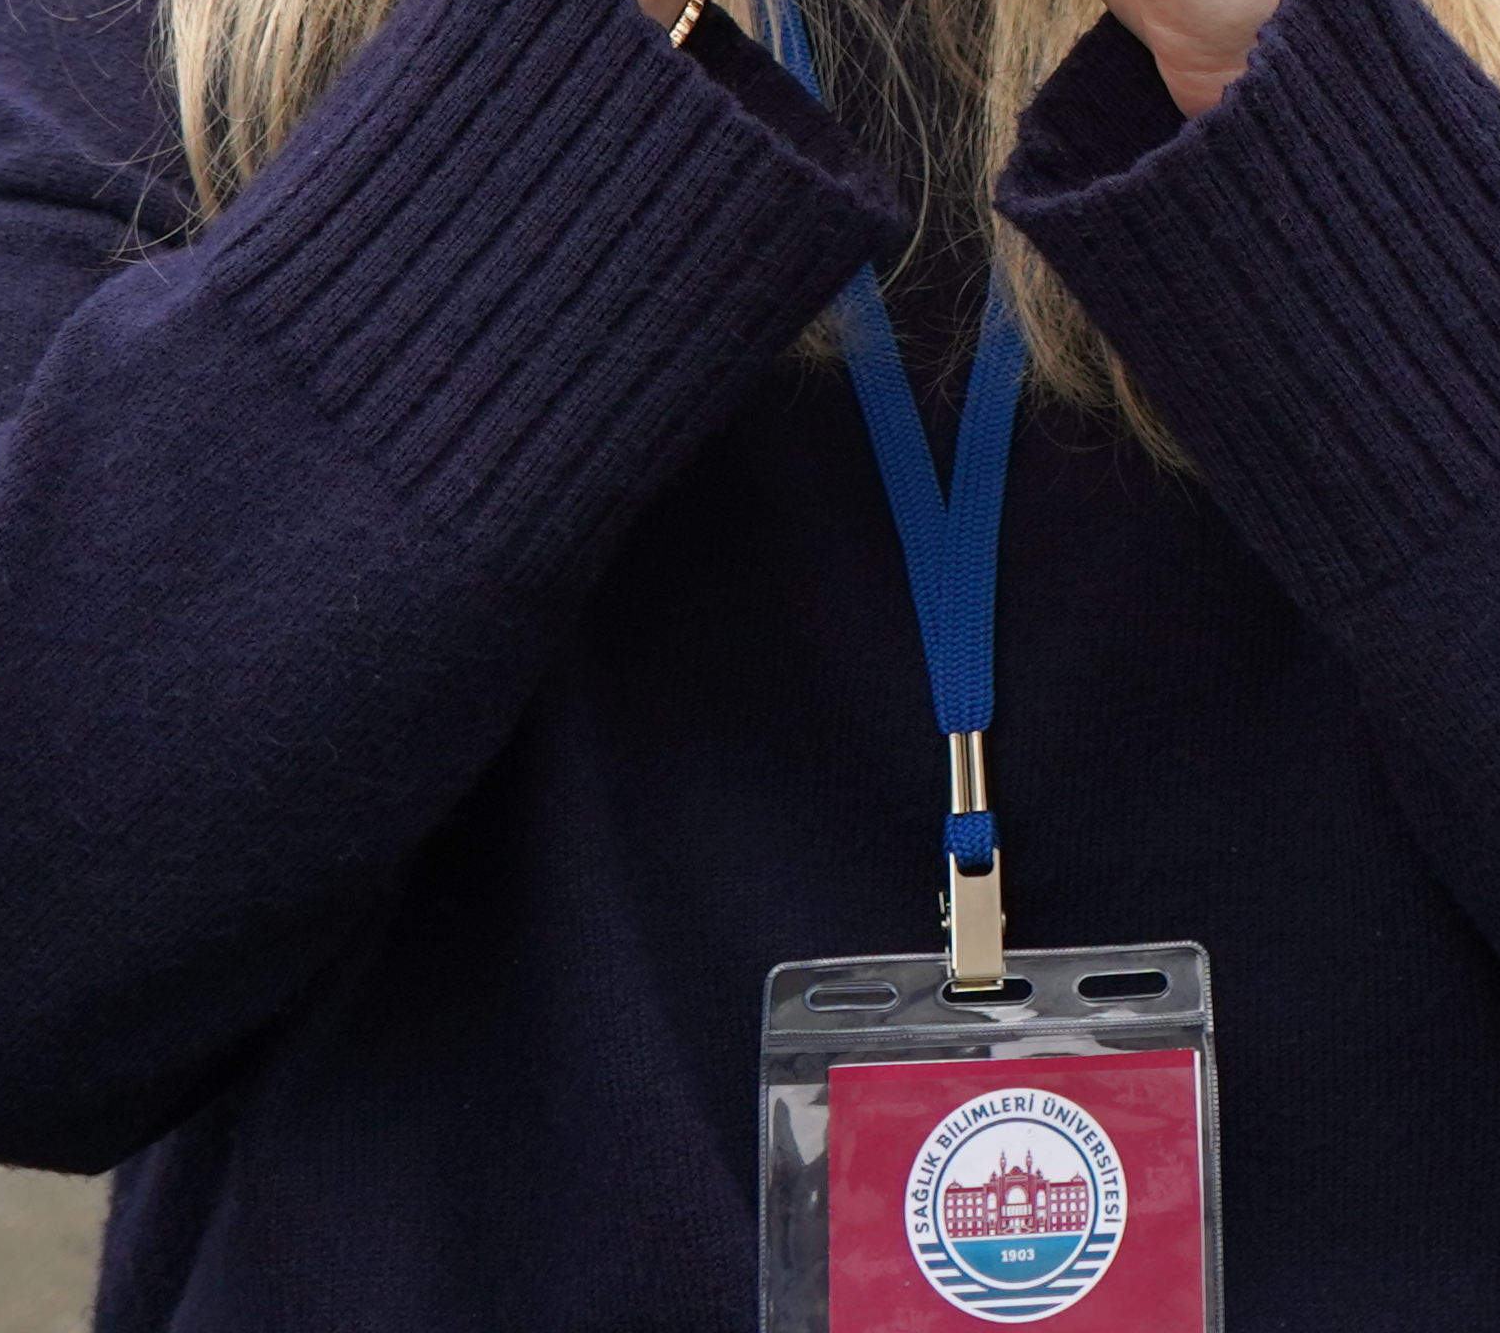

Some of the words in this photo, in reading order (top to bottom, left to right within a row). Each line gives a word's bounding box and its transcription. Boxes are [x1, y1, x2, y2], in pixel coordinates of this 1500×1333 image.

[911, 1151, 942, 1234] SAĞLIK
[936, 1093, 1035, 1151] BİLİMLERİ
[1042, 1096, 1122, 1224] ÜNİVERSİTESİ
[1001, 1248, 1035, 1263] 1903
